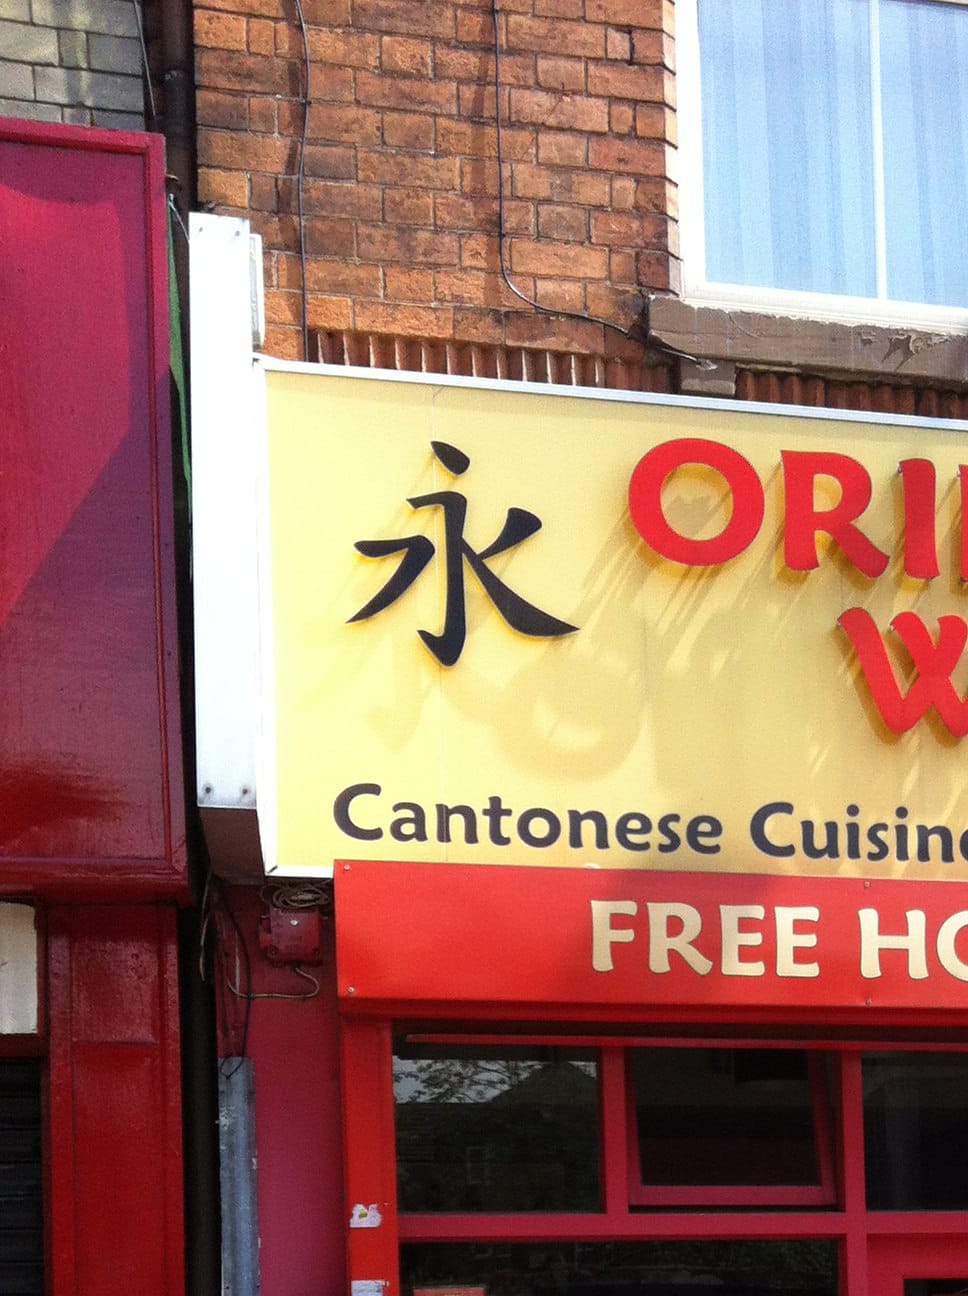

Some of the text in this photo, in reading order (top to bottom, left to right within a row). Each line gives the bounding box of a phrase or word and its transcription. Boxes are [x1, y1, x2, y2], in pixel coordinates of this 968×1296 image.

[345, 440, 580, 668] 永
[333, 782, 724, 855] Cantonese
[589, 899, 821, 979] FREE
